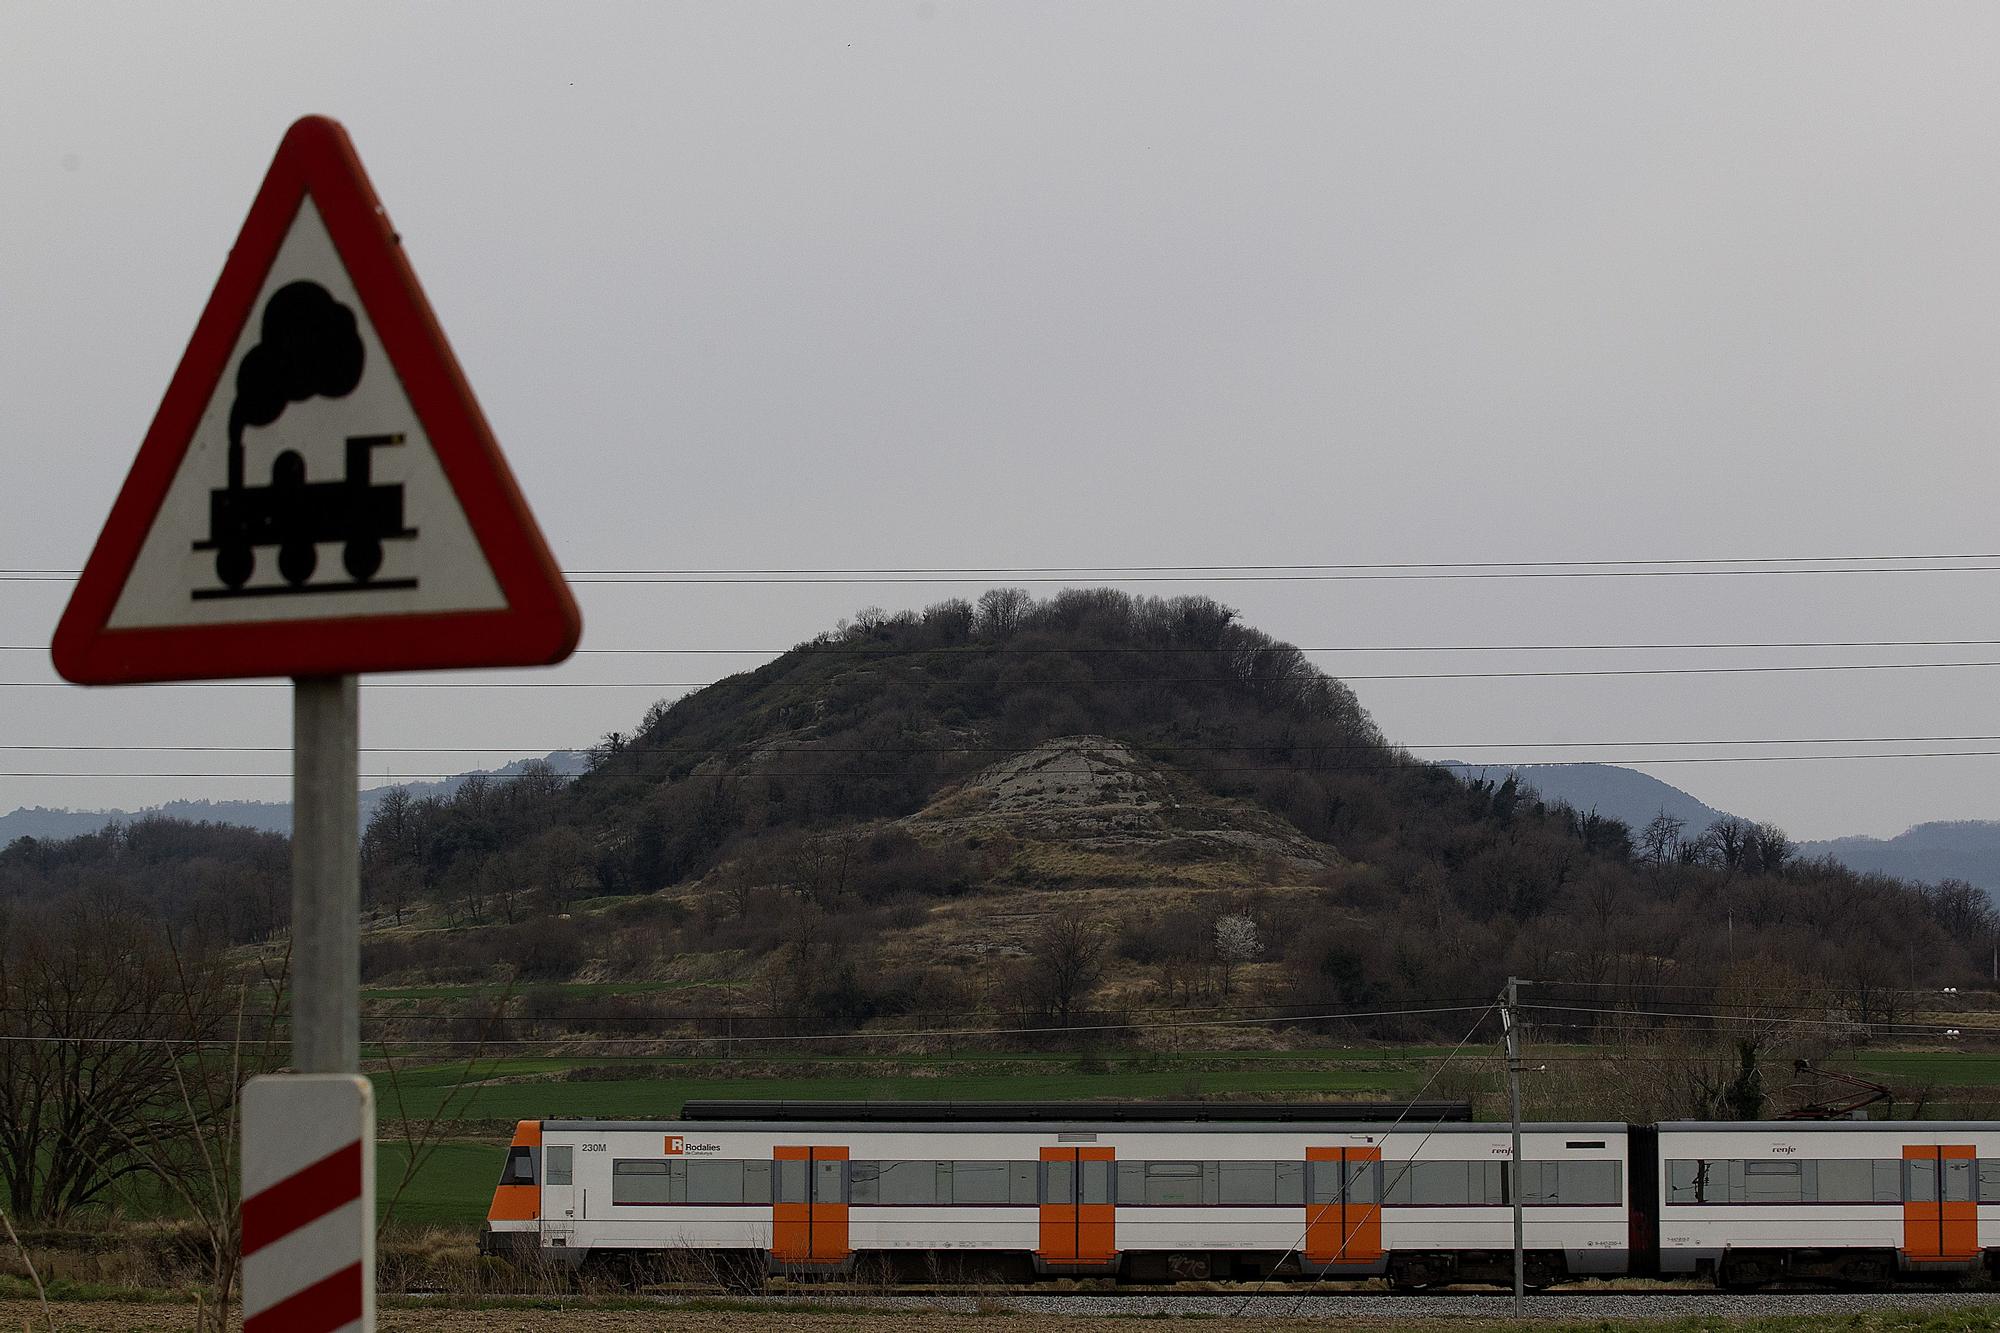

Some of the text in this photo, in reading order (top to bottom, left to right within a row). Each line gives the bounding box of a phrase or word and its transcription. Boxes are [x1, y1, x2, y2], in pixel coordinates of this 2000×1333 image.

[582, 1144, 607, 1152] 230M
[685, 1143, 721, 1151] Rodalies
[1772, 1146, 1796, 1155] renfe
